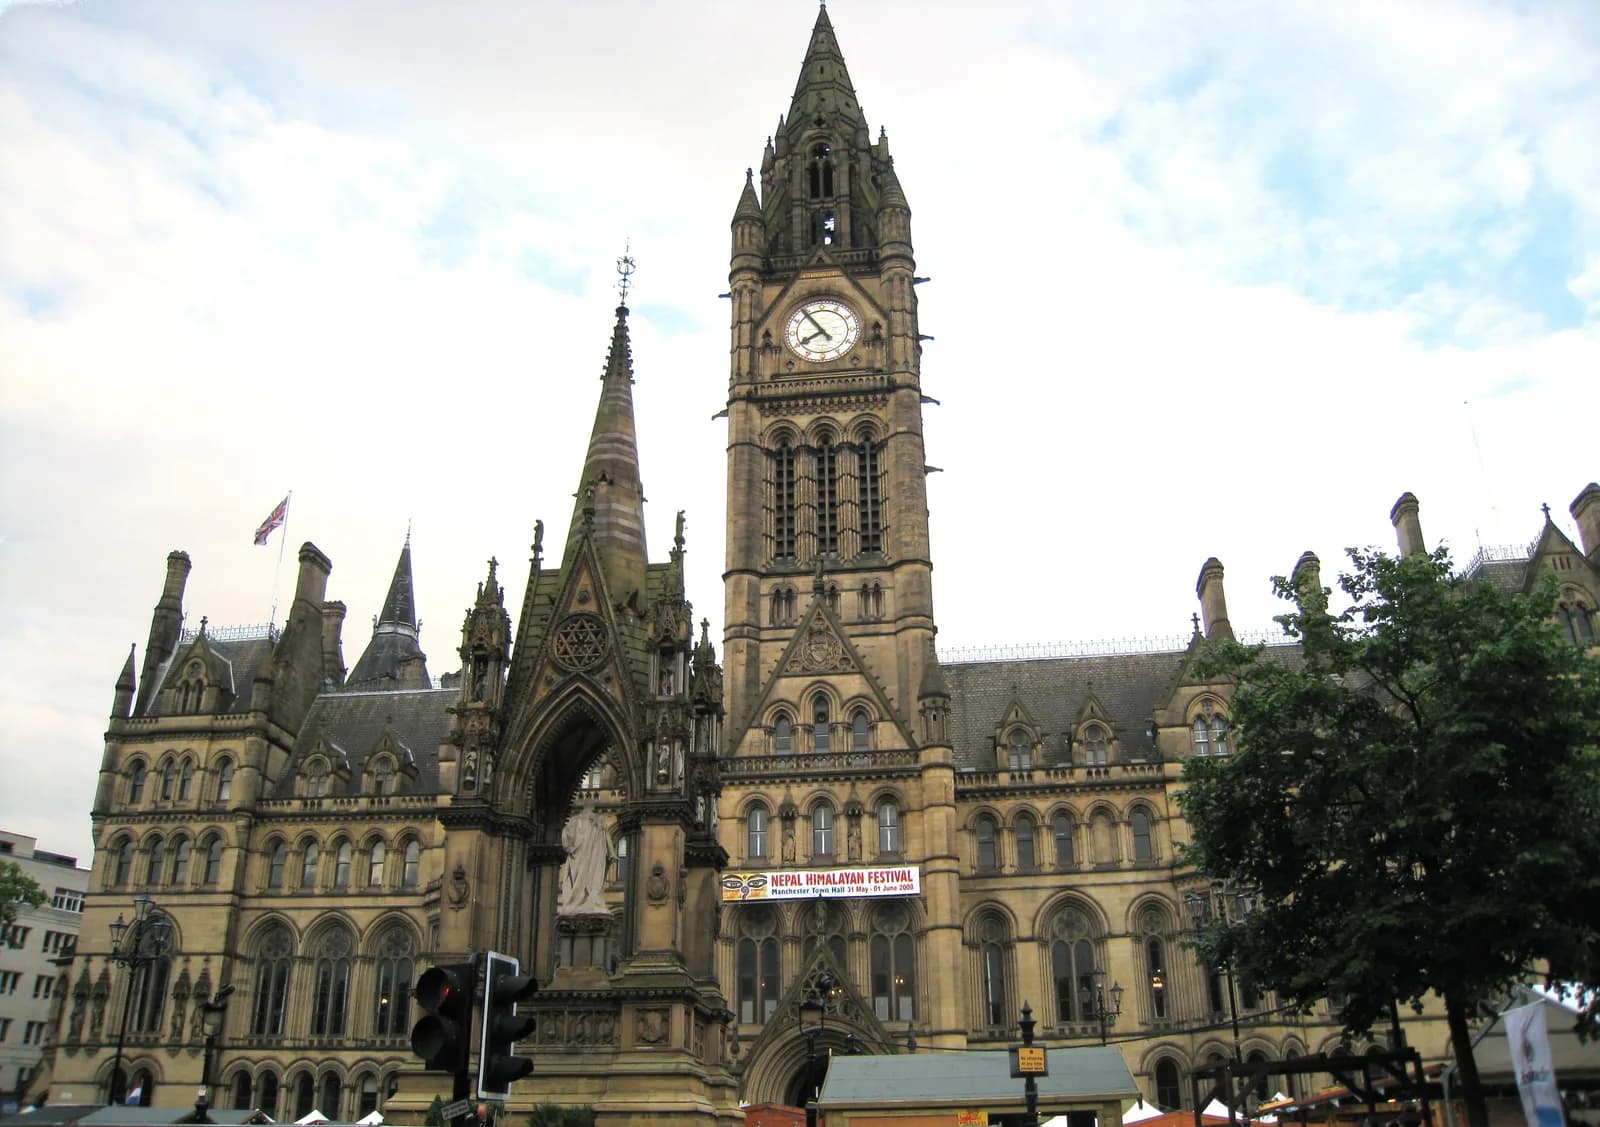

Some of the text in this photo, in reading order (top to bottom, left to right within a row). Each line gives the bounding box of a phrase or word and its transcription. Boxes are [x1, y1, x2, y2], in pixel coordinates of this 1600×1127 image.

[771, 869, 913, 887] NEPAL HIMALAYAN FESTIVAL
[771, 887, 809, 896] Manchester
[812, 886, 829, 894] Town
[831, 886, 845, 894] Hall
[856, 885, 868, 894] May
[883, 884, 898, 892] June
